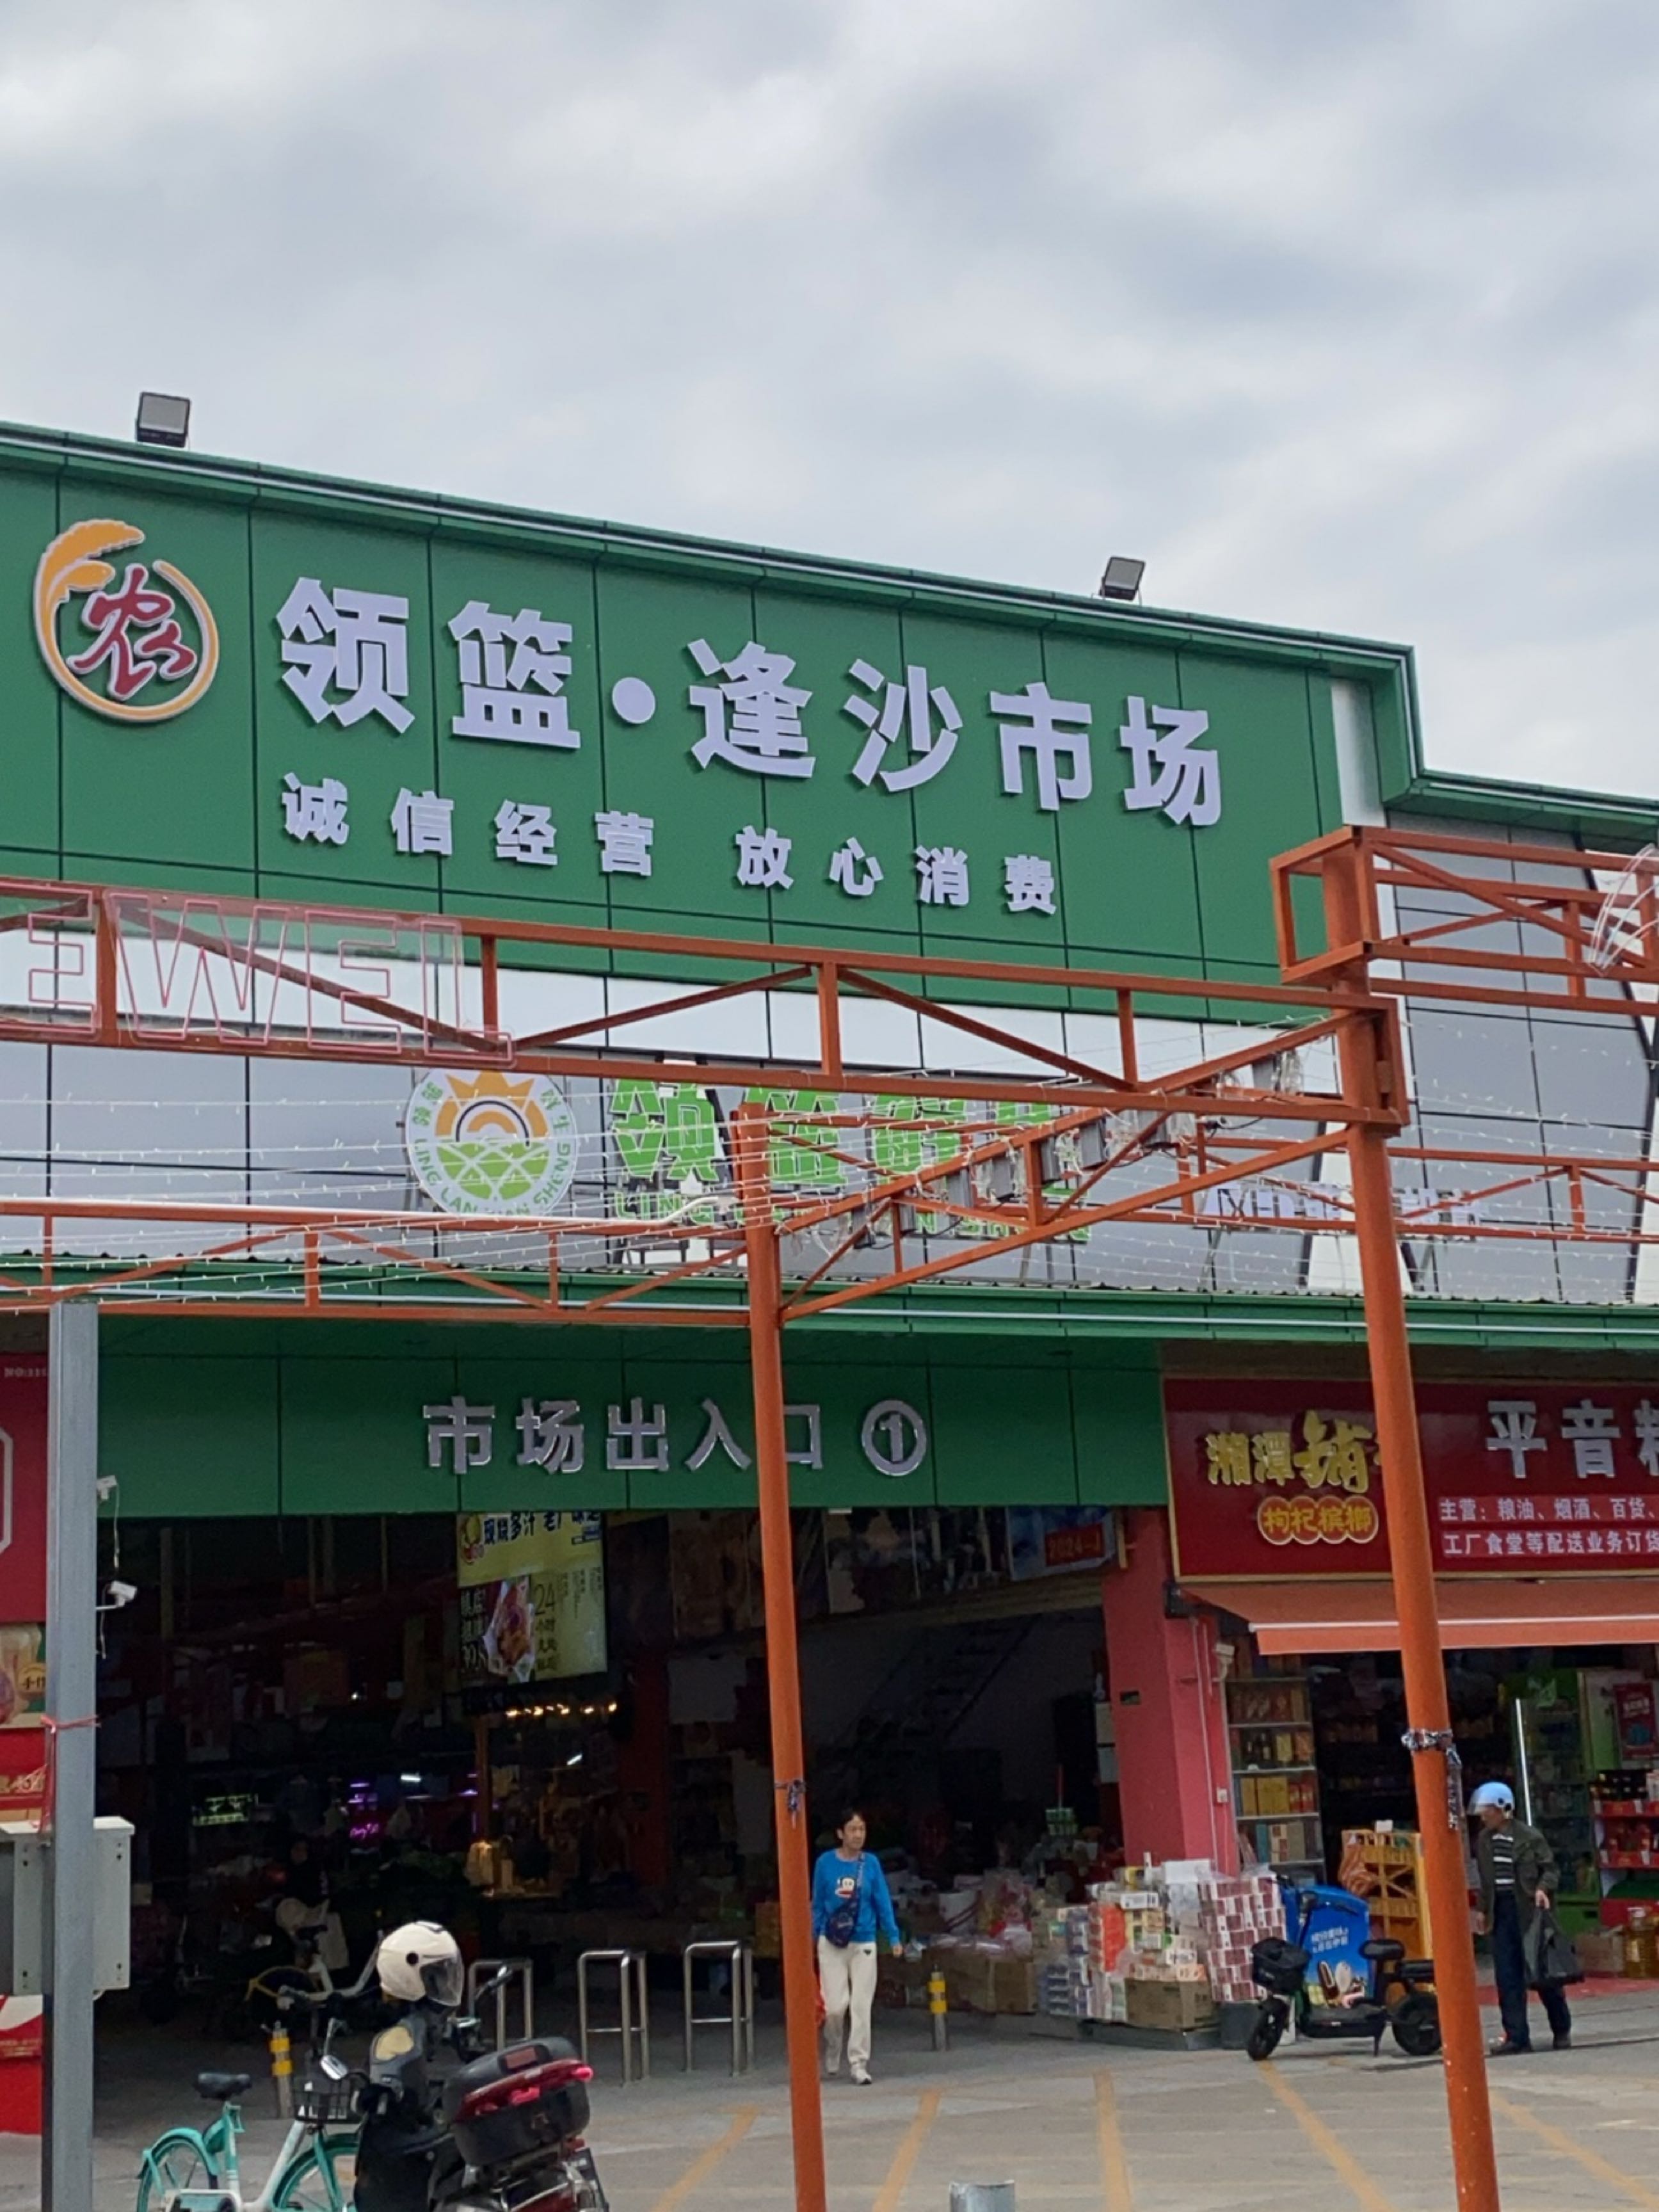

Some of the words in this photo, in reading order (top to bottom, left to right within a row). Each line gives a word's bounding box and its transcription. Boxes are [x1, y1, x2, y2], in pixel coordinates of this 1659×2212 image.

[282, 773, 653, 876] 诚信经营
[735, 826, 1057, 914] 放心消费
[1204, 1409, 1381, 1494] 湘潭铺
[1263, 1505, 1371, 1534] 枸杞槟榔
